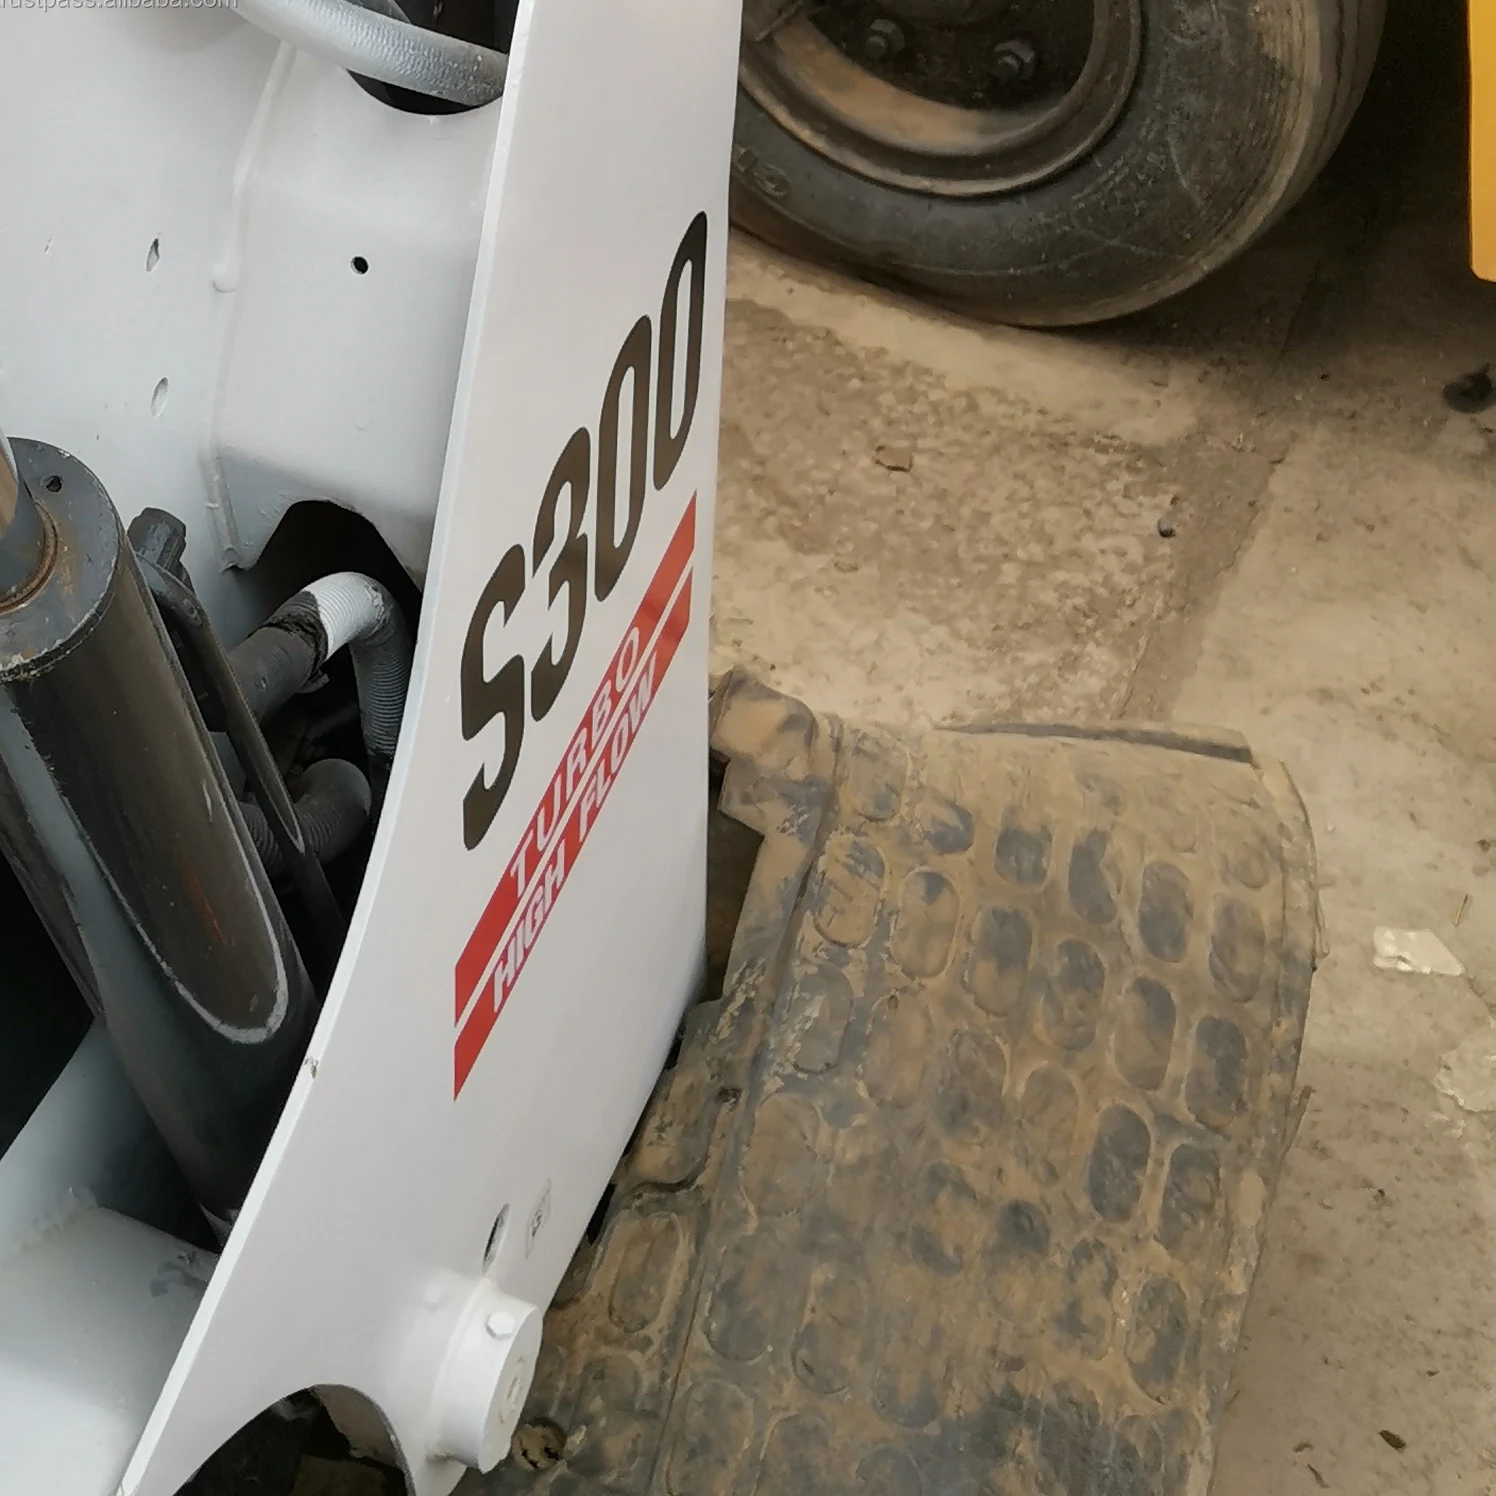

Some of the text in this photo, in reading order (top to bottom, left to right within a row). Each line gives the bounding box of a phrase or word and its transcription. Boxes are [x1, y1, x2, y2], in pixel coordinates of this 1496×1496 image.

[461, 210, 708, 851] S300
[493, 651, 658, 1014] HIGH FLOW
[510, 626, 640, 899] TURBO
